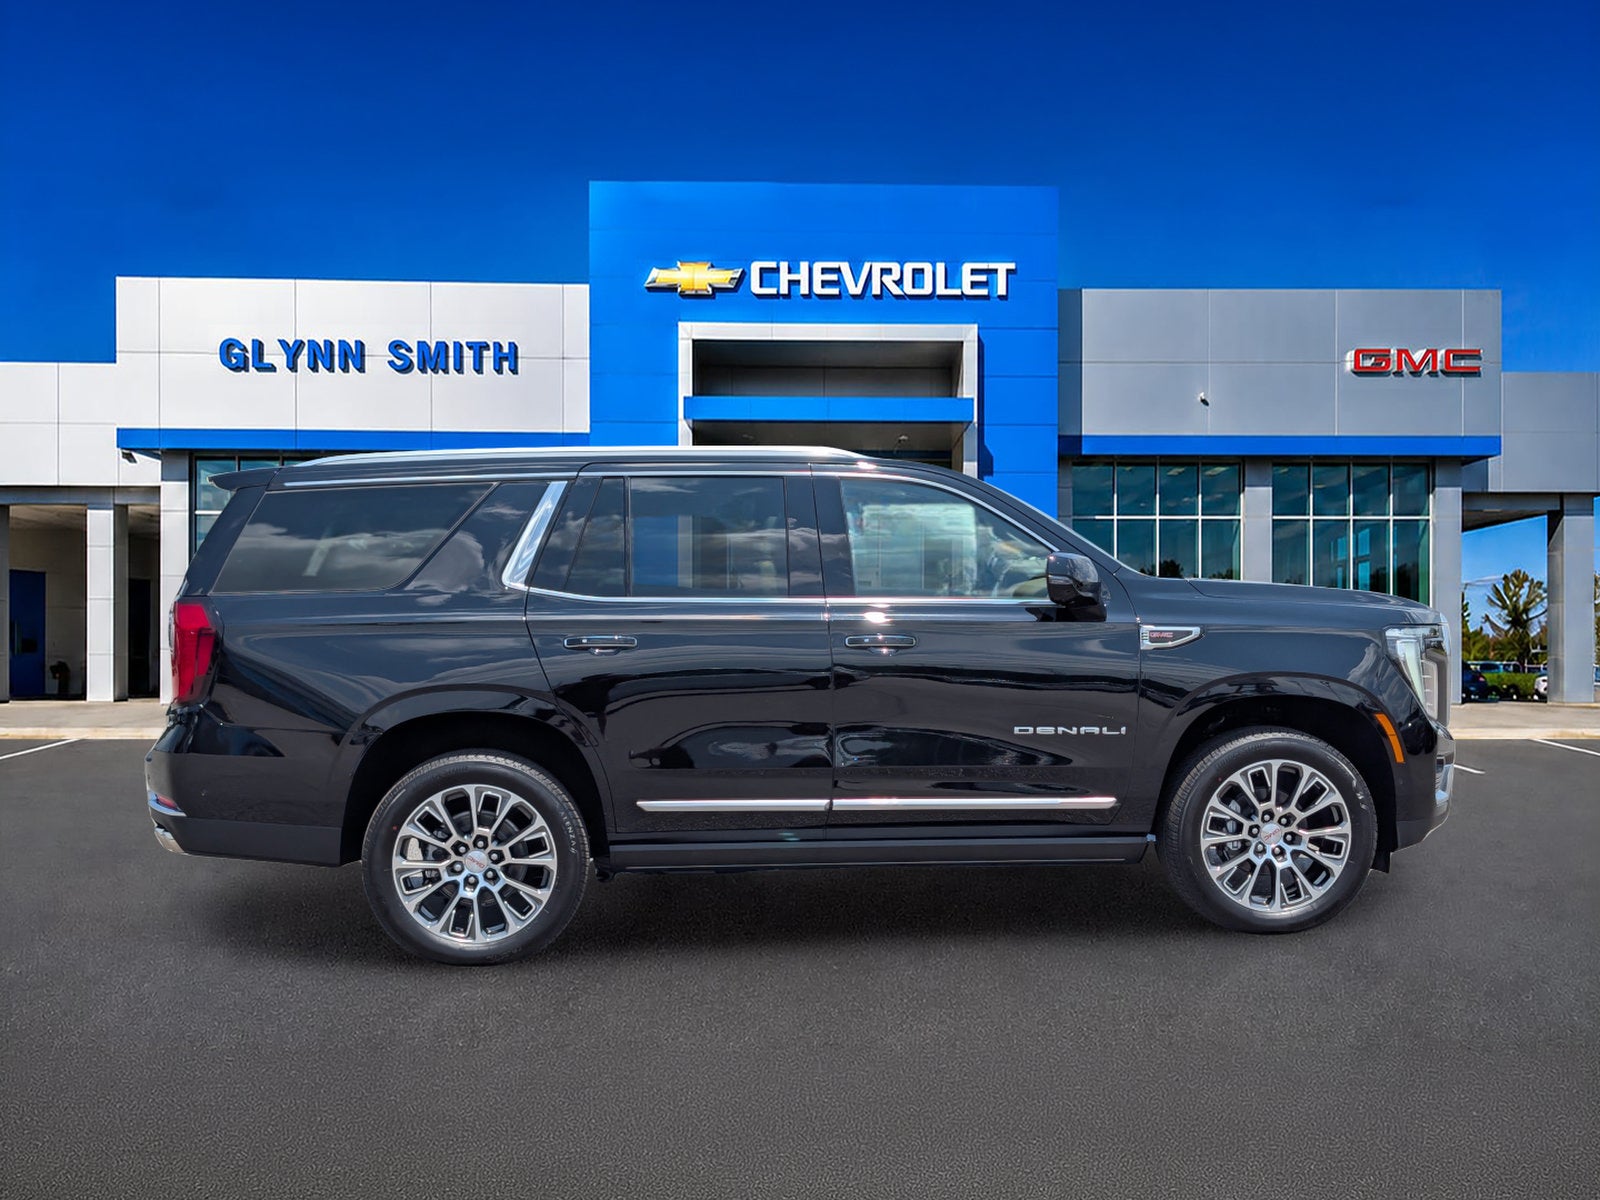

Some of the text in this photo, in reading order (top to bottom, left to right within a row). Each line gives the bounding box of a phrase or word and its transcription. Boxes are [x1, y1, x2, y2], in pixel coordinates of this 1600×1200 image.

[750, 261, 1017, 298] CHEVROLET
[219, 338, 519, 375] GLYNN SMITH
[1350, 347, 1483, 377] GMC
[1013, 726, 1127, 735] DENALI
